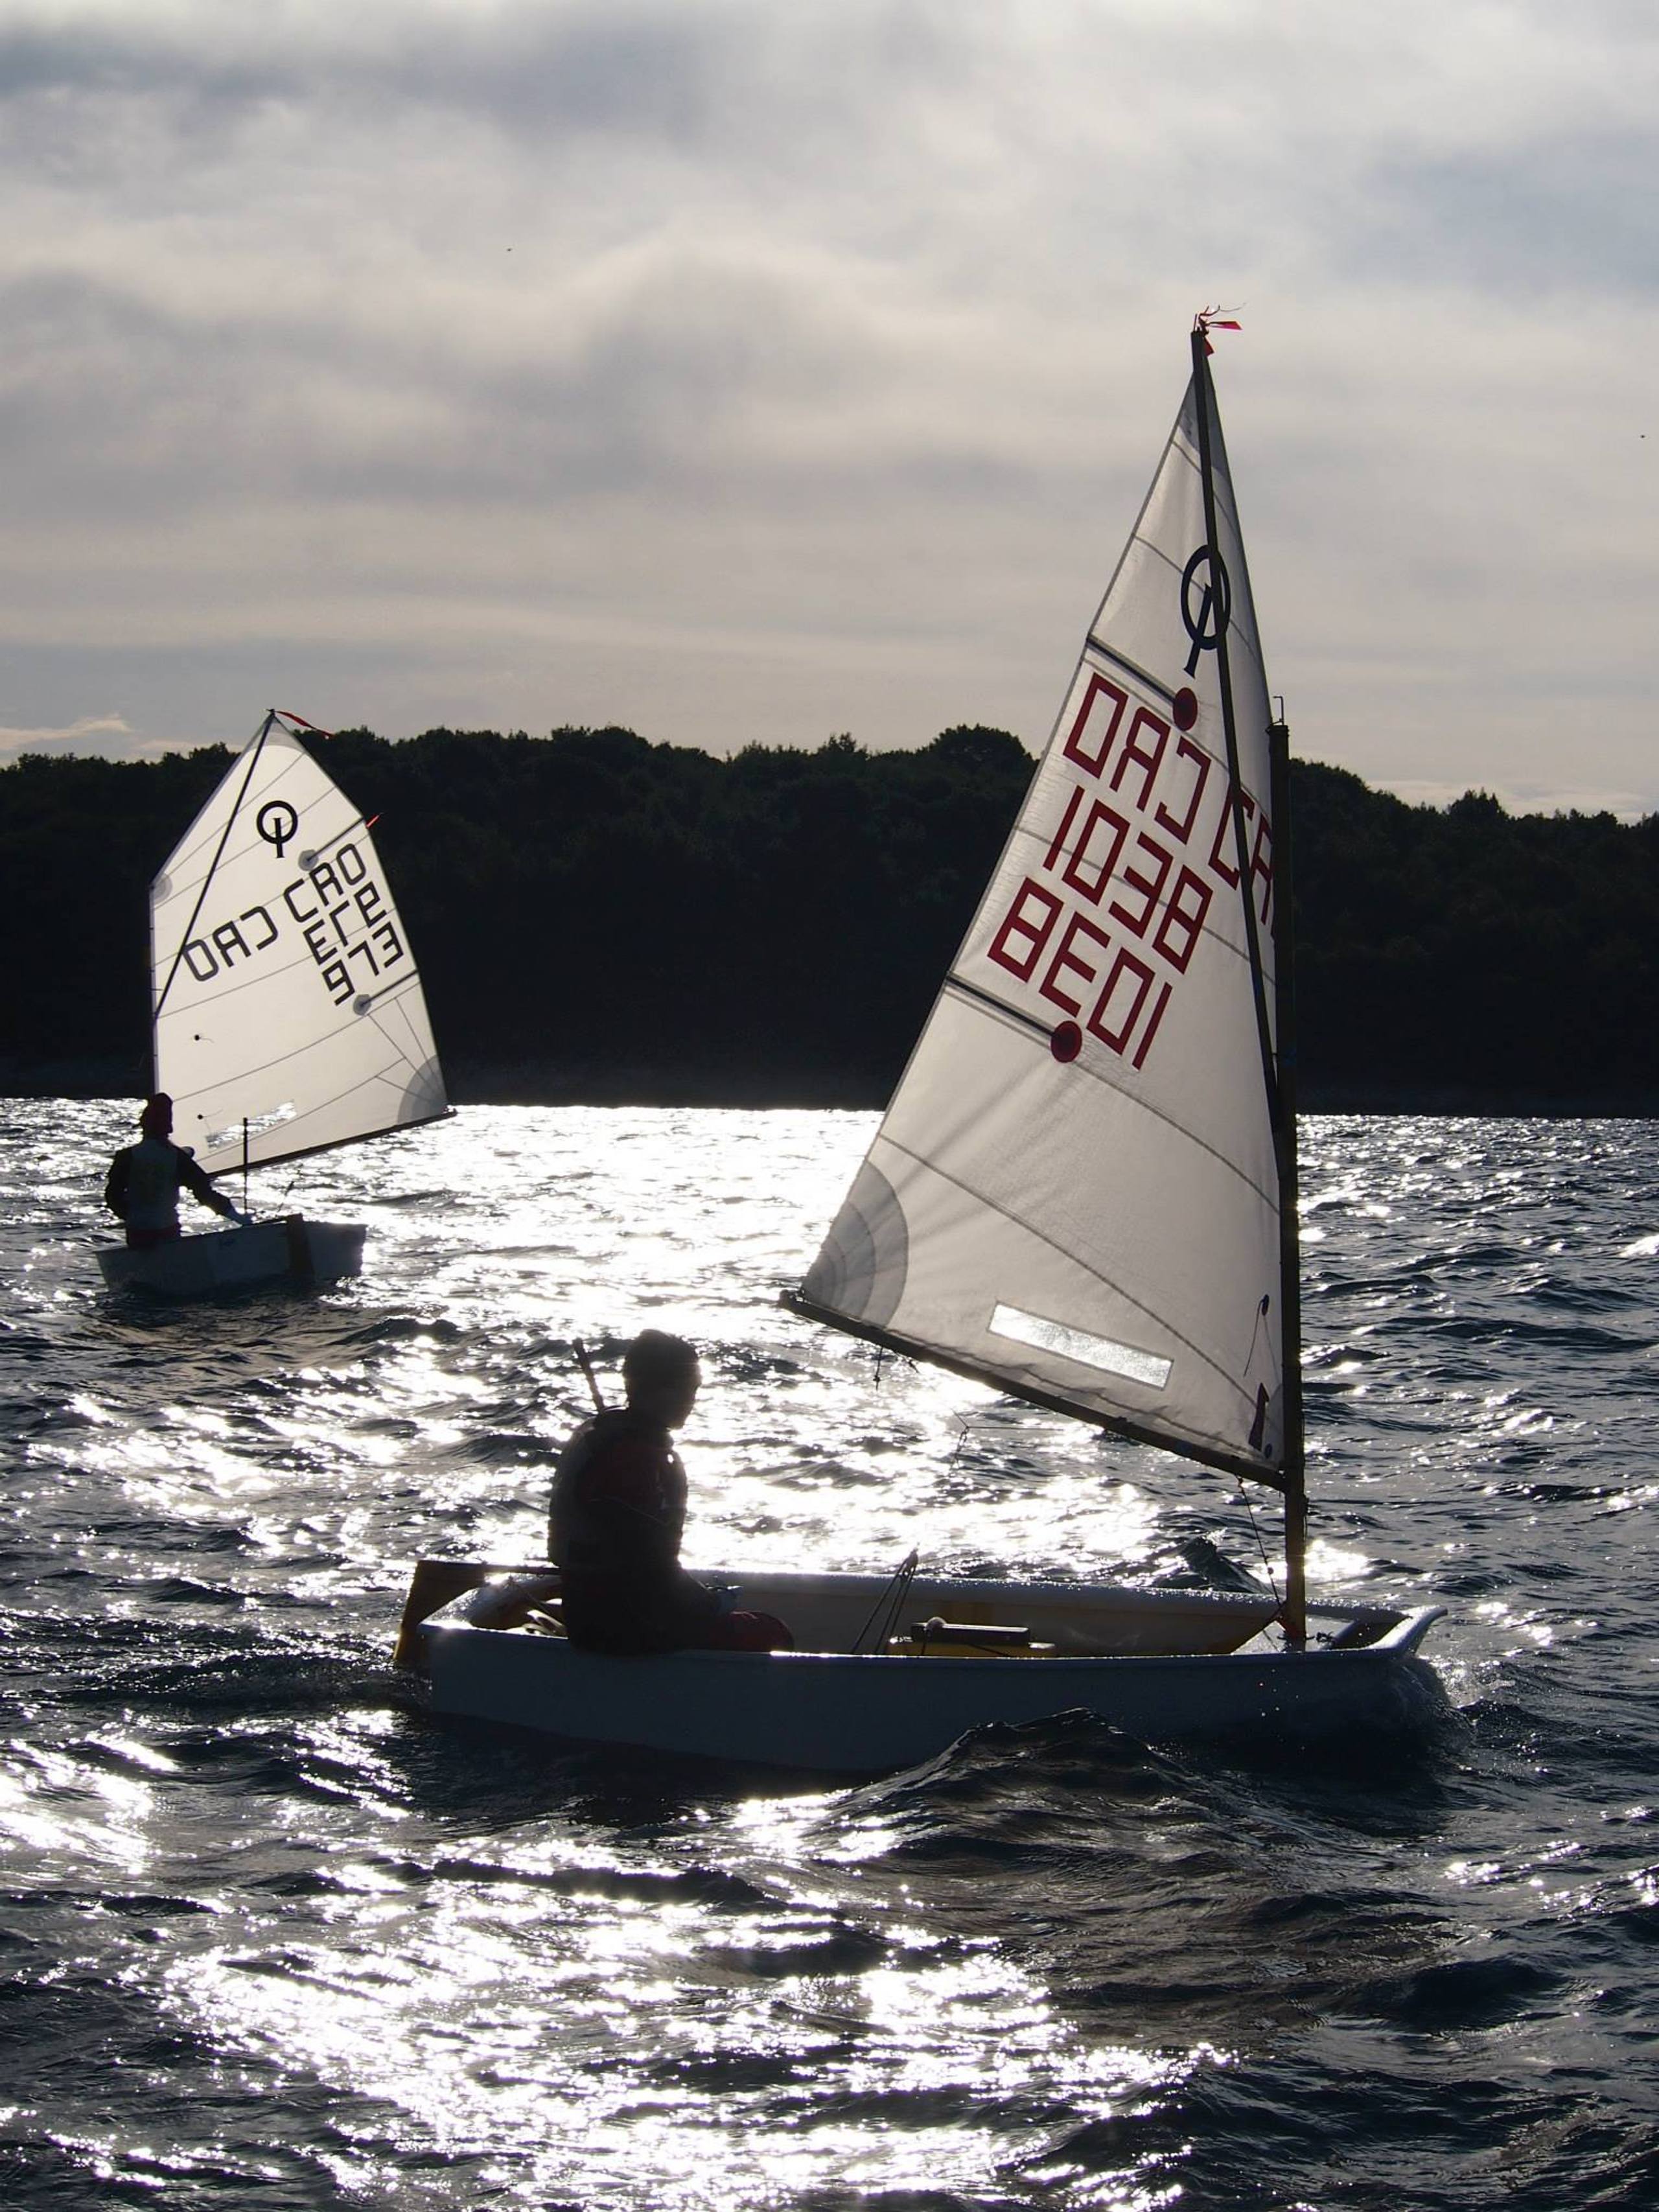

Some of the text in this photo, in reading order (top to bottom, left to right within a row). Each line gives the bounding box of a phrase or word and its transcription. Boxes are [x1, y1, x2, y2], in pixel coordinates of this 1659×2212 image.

[284, 843, 367, 923] CRO
[1043, 785, 1213, 975] 1038
[1208, 782, 1273, 927] CR
[321, 921, 404, 1006] 973
